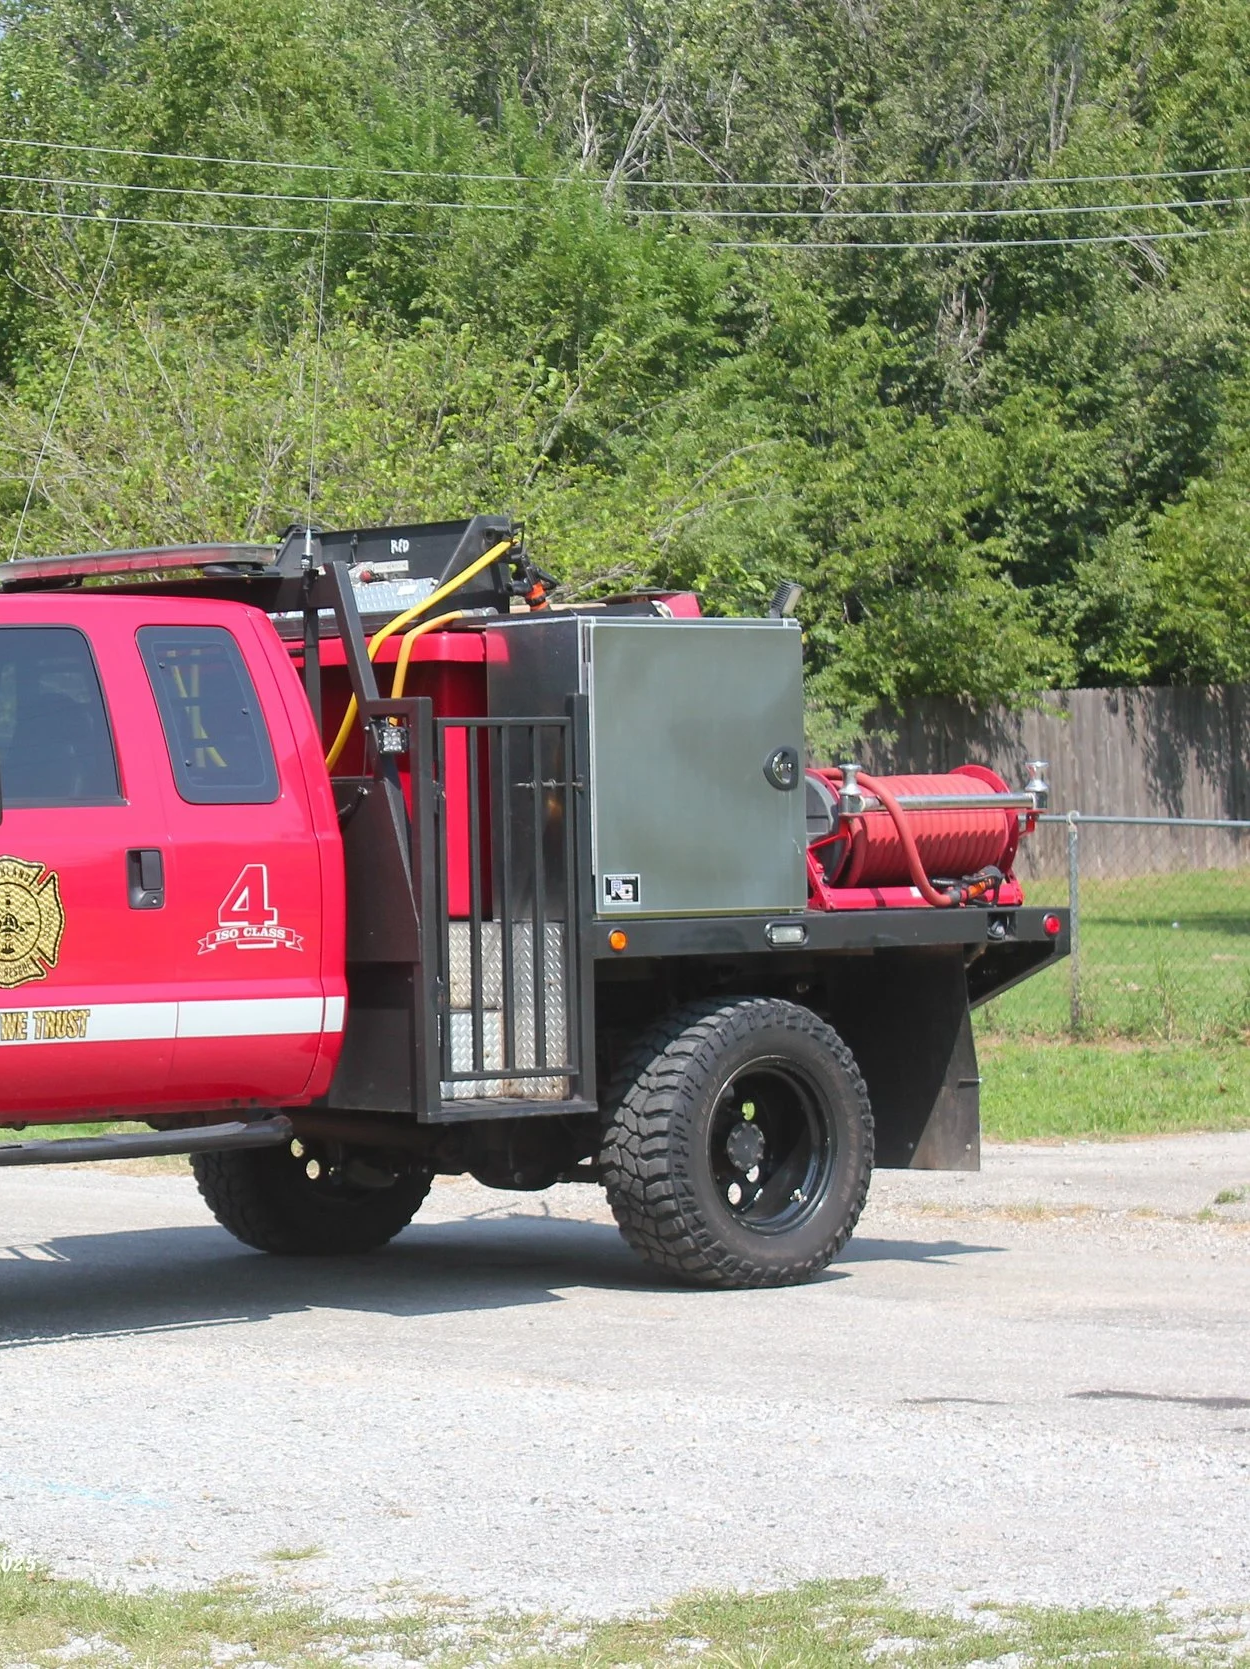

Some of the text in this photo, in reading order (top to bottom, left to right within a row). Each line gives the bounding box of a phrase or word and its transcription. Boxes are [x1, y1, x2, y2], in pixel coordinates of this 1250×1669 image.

[218, 864, 278, 949] 4
[215, 927, 286, 942] ISO CLASS
[1, 1011, 29, 1041] WE
[33, 1009, 90, 1040] TRUST
